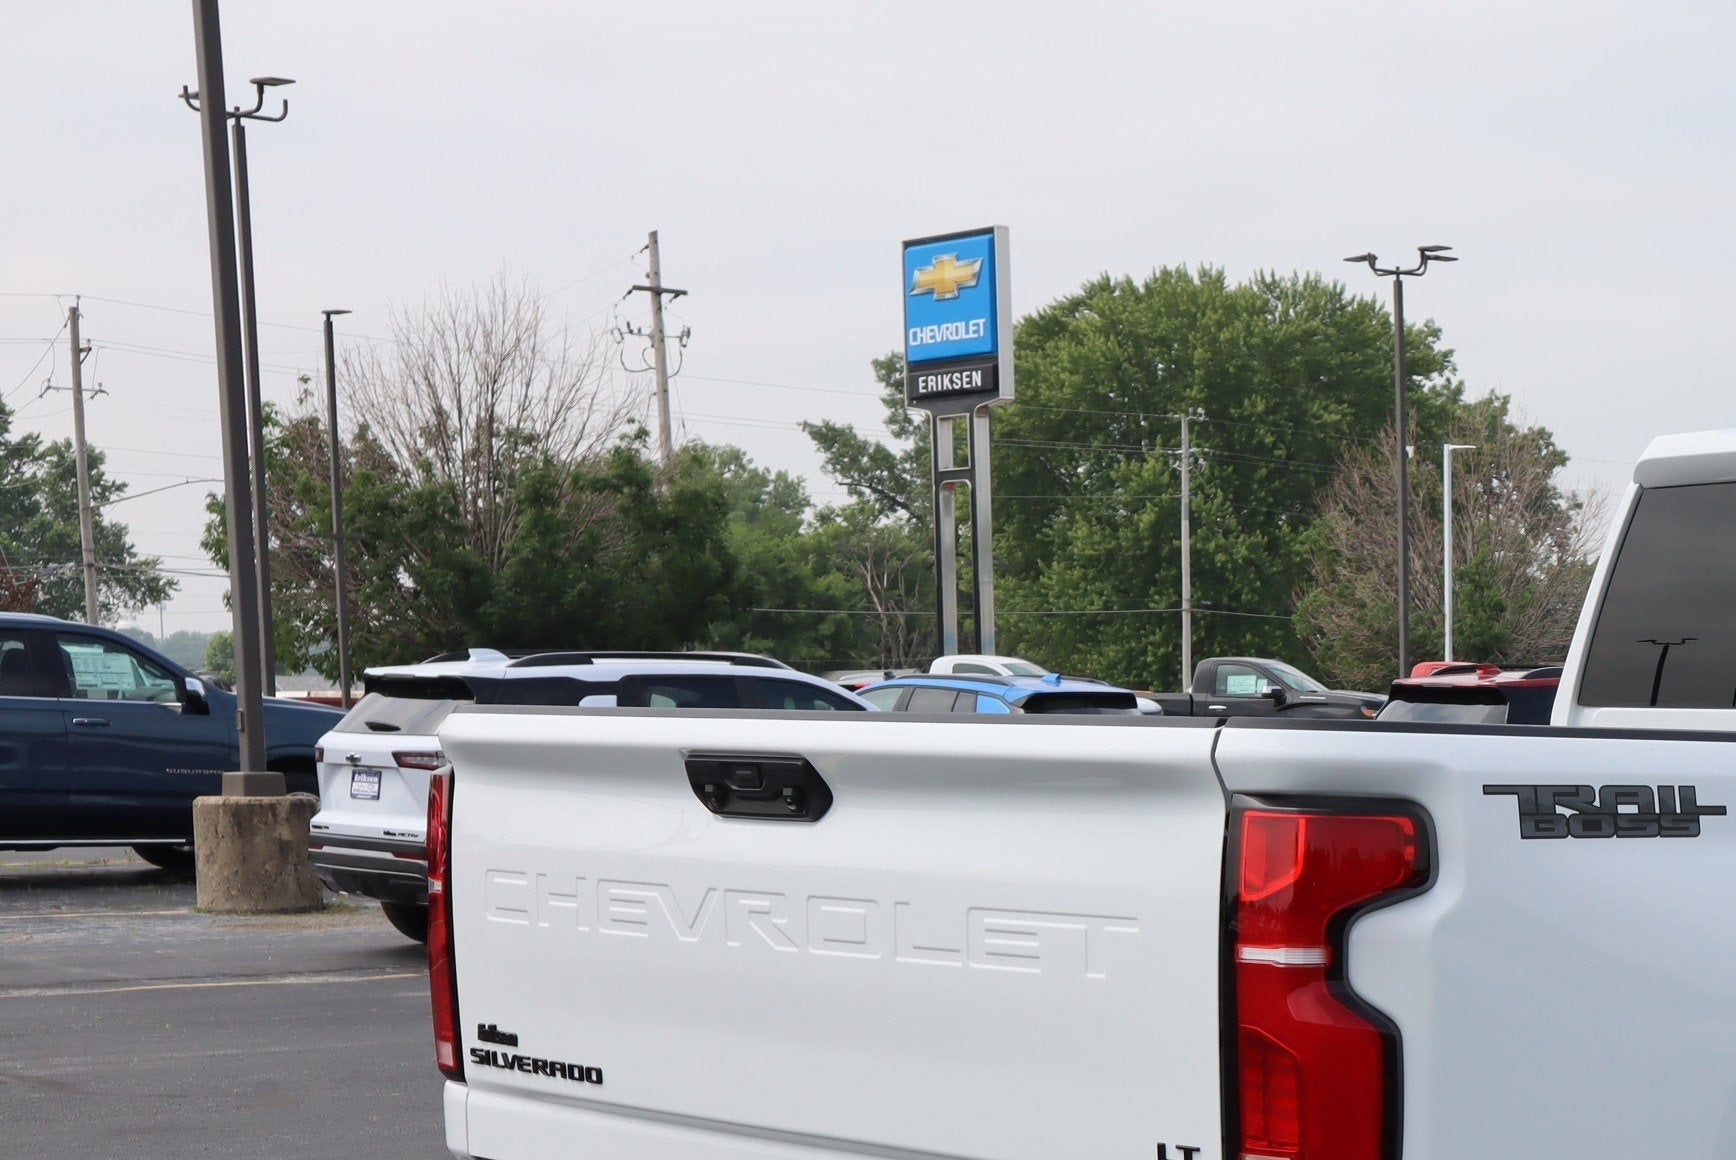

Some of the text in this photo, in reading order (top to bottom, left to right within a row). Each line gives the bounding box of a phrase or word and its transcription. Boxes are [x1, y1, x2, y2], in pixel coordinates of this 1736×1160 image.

[908, 318, 986, 346] CHEVROLET
[918, 370, 982, 393] ERIKSEN
[1520, 812, 1701, 839] BOSS
[485, 867, 1140, 979] CHEVROLET
[470, 1047, 603, 1084] SILVERADO
